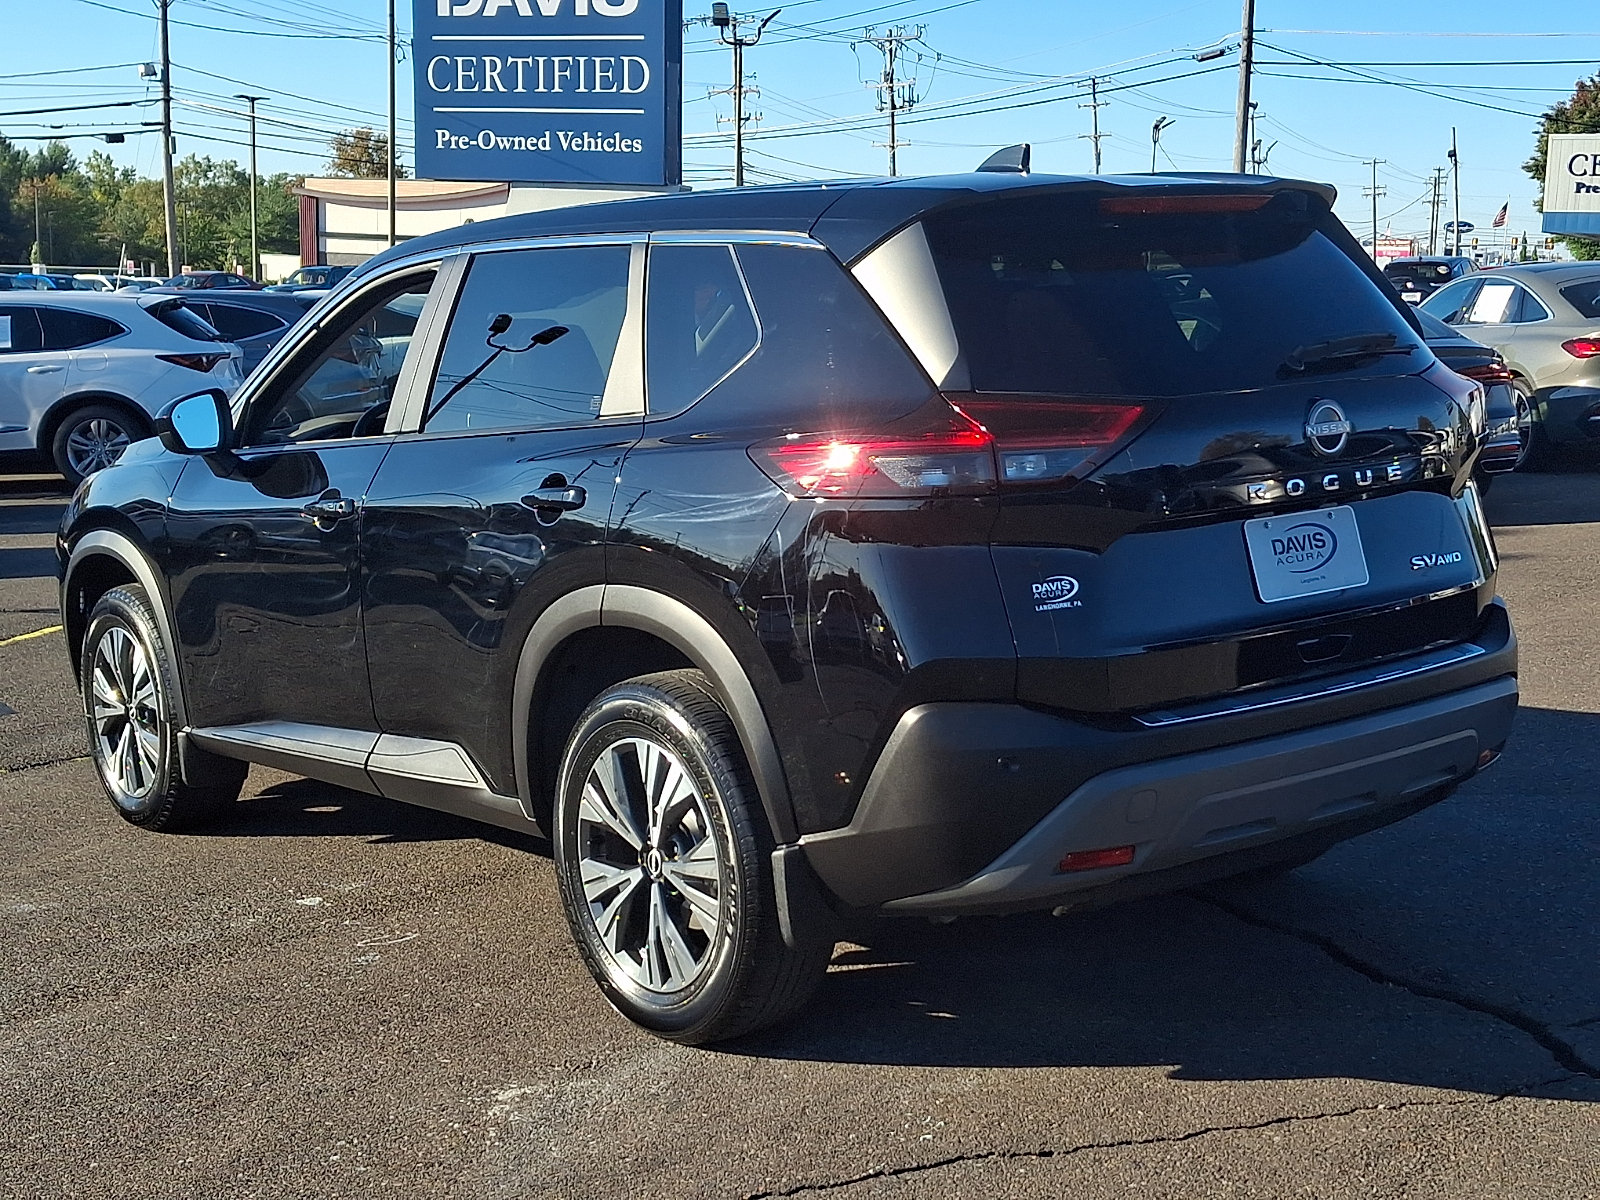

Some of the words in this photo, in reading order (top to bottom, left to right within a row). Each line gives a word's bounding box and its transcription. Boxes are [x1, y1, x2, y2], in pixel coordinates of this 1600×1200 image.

[427, 55, 650, 94] CERTIFIED
[435, 129, 550, 151] Pre-Owned
[556, 131, 642, 152] Vehicles
[1306, 421, 1350, 437] NISSAN
[1247, 465, 1402, 500] ROGUE
[1271, 532, 1326, 556] DAVIS
[1276, 551, 1325, 566] ACURA
[1032, 580, 1070, 593] DAVIS
[1034, 590, 1068, 599] ACURA
